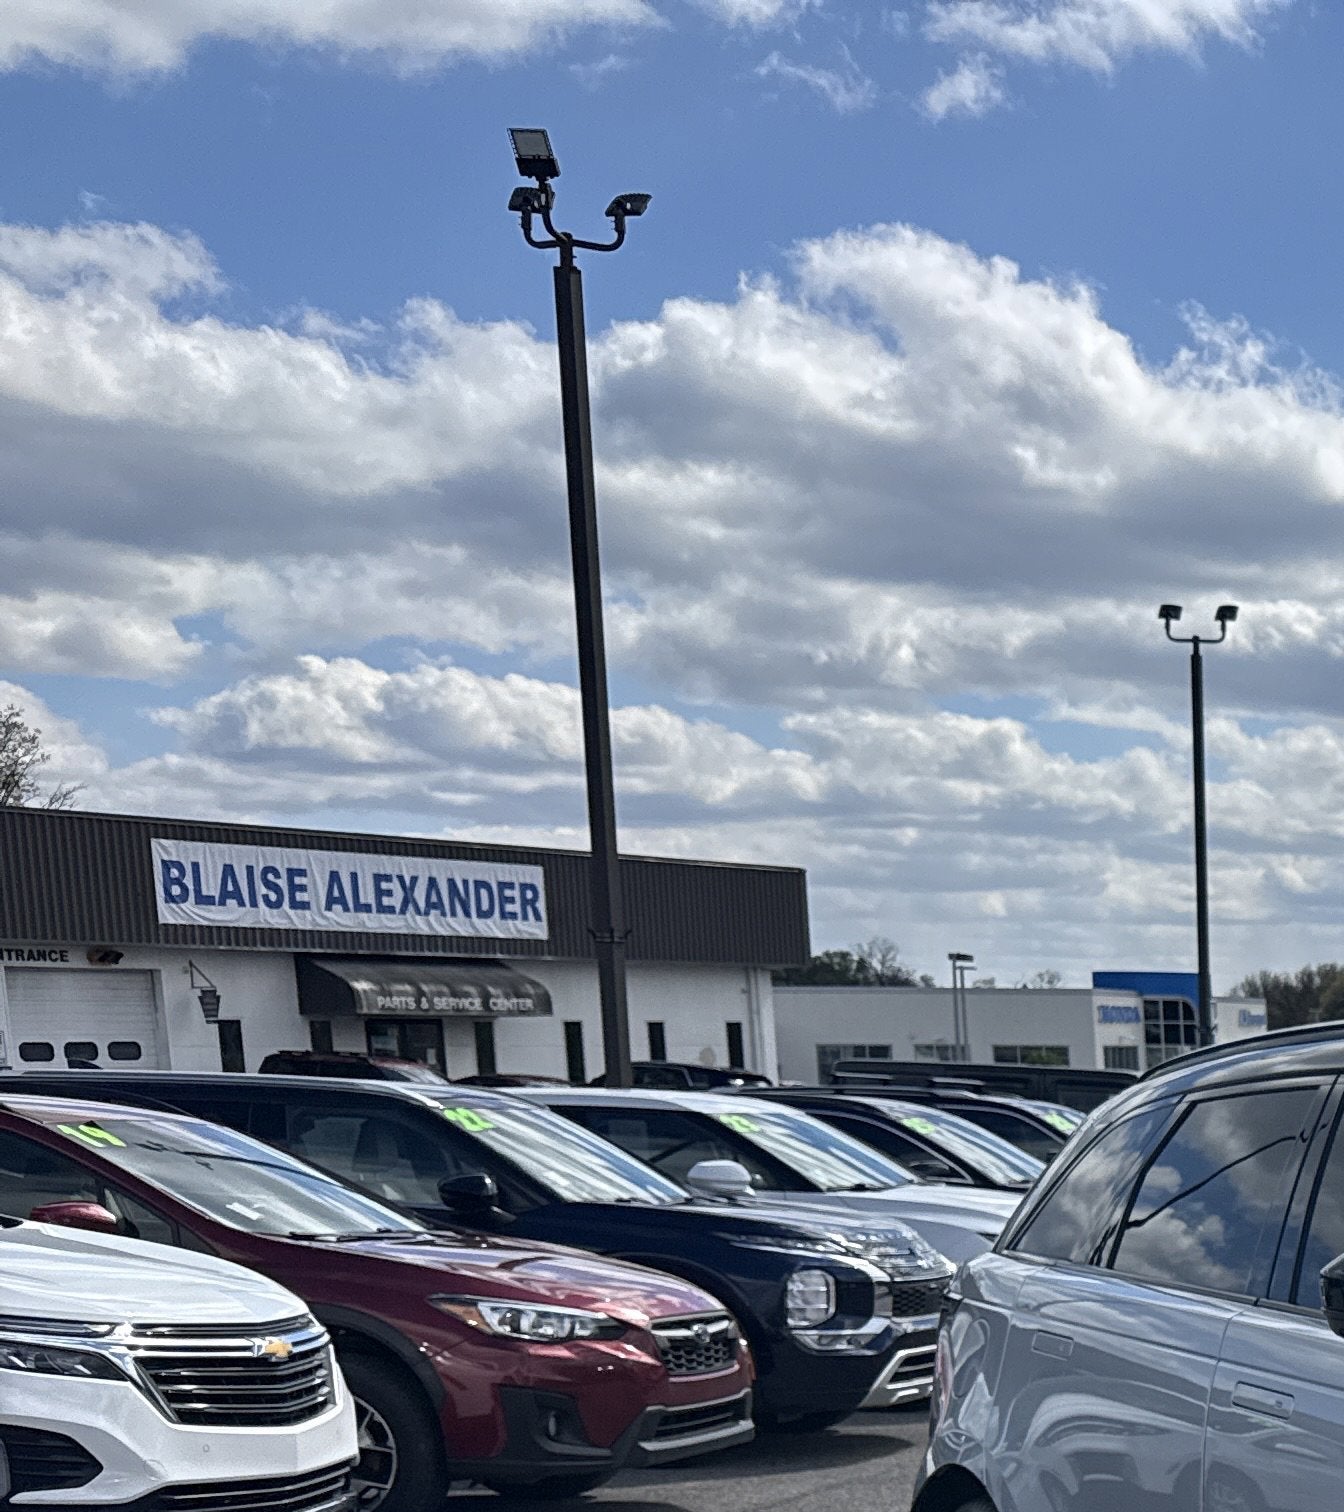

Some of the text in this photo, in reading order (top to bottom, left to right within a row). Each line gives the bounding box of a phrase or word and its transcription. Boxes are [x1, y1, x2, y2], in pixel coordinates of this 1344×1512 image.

[160, 858, 543, 923] BLAISE ALEXANDER
[376, 996, 416, 1010] PARTS
[433, 996, 484, 1011] SERVICE
[489, 998, 534, 1012] CENTER
